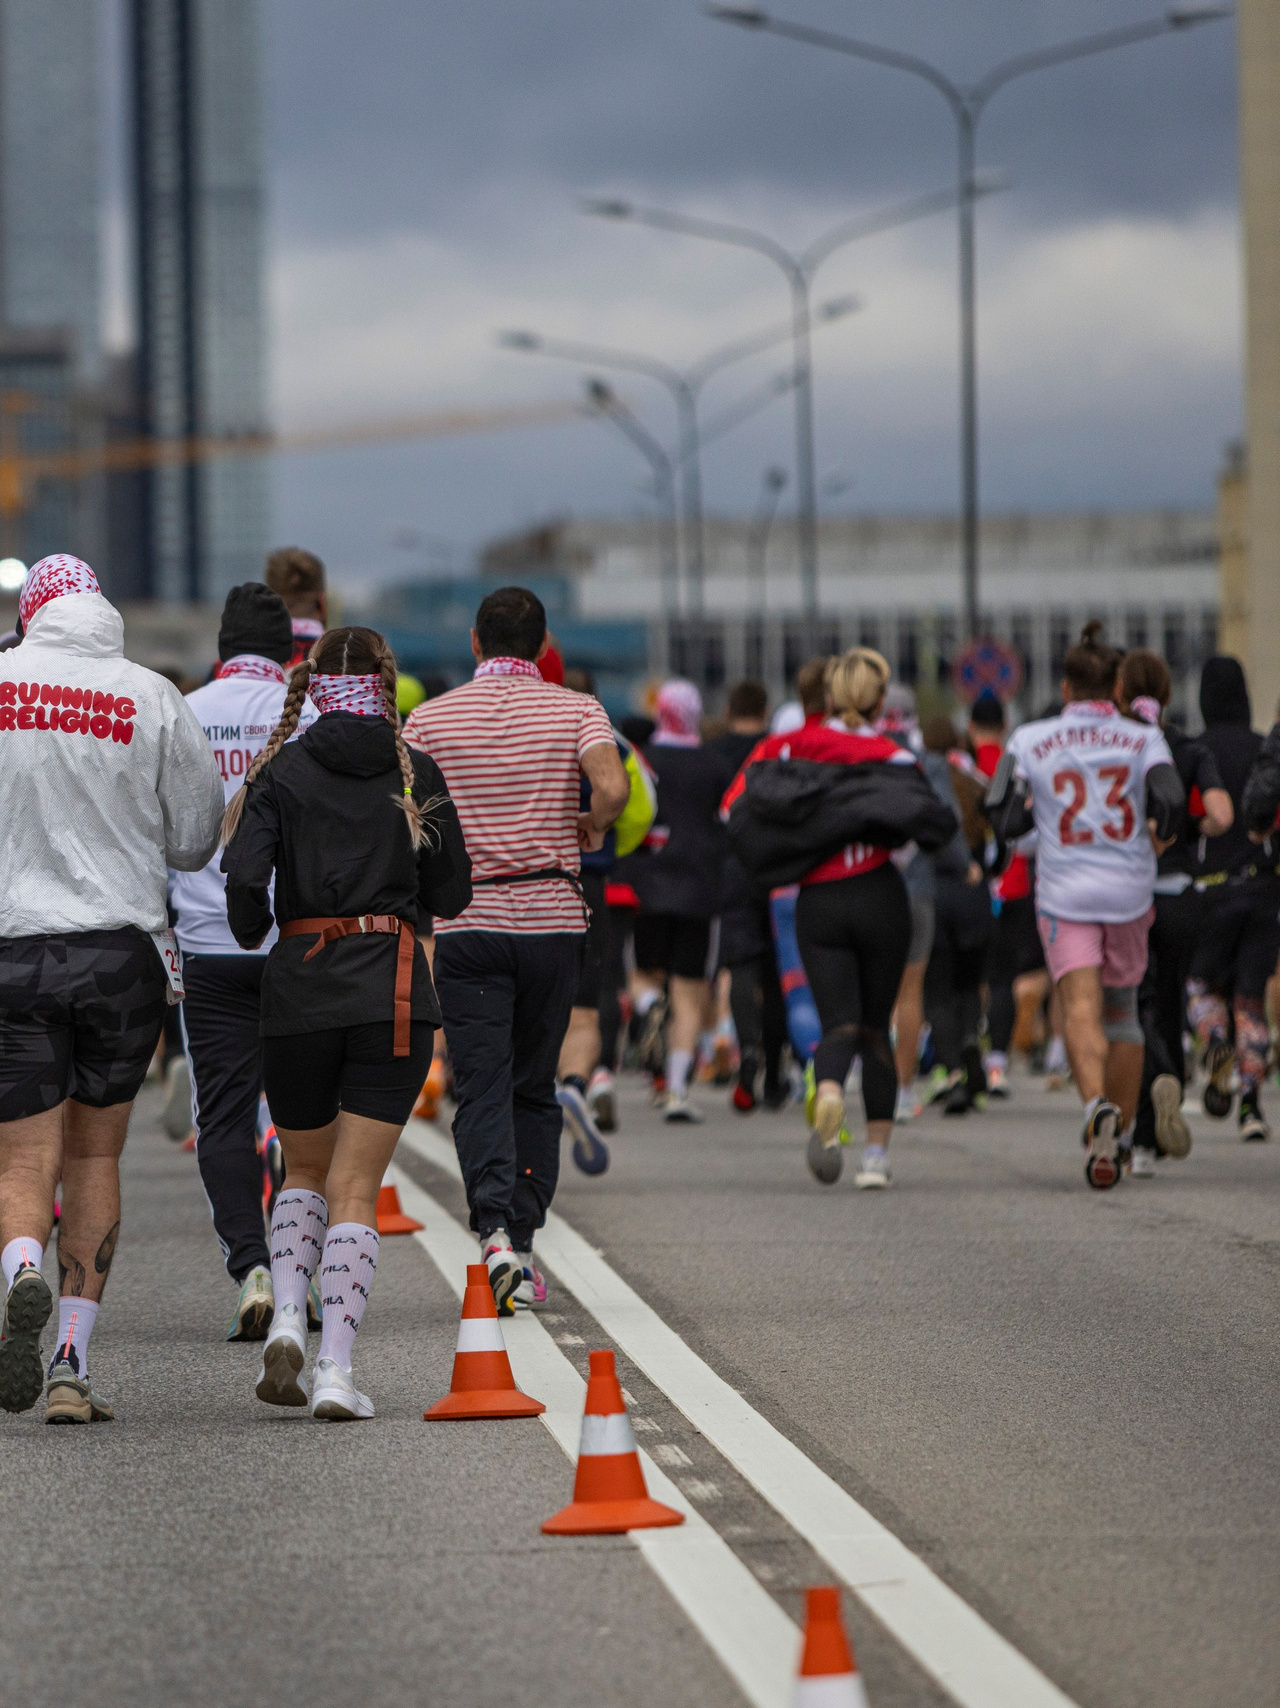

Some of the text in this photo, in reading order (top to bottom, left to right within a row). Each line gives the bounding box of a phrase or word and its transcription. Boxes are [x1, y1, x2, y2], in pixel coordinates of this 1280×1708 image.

[203, 725, 241, 741] ИТИМ
[1053, 765, 1133, 844] 23
[274, 1198, 304, 1211] FILA
[272, 1220, 298, 1237] FILA
[327, 1237, 357, 1248] FILA
[272, 1247, 294, 1264] FILA
[322, 1264, 350, 1276] FILA
[323, 1296, 344, 1308] FILA
